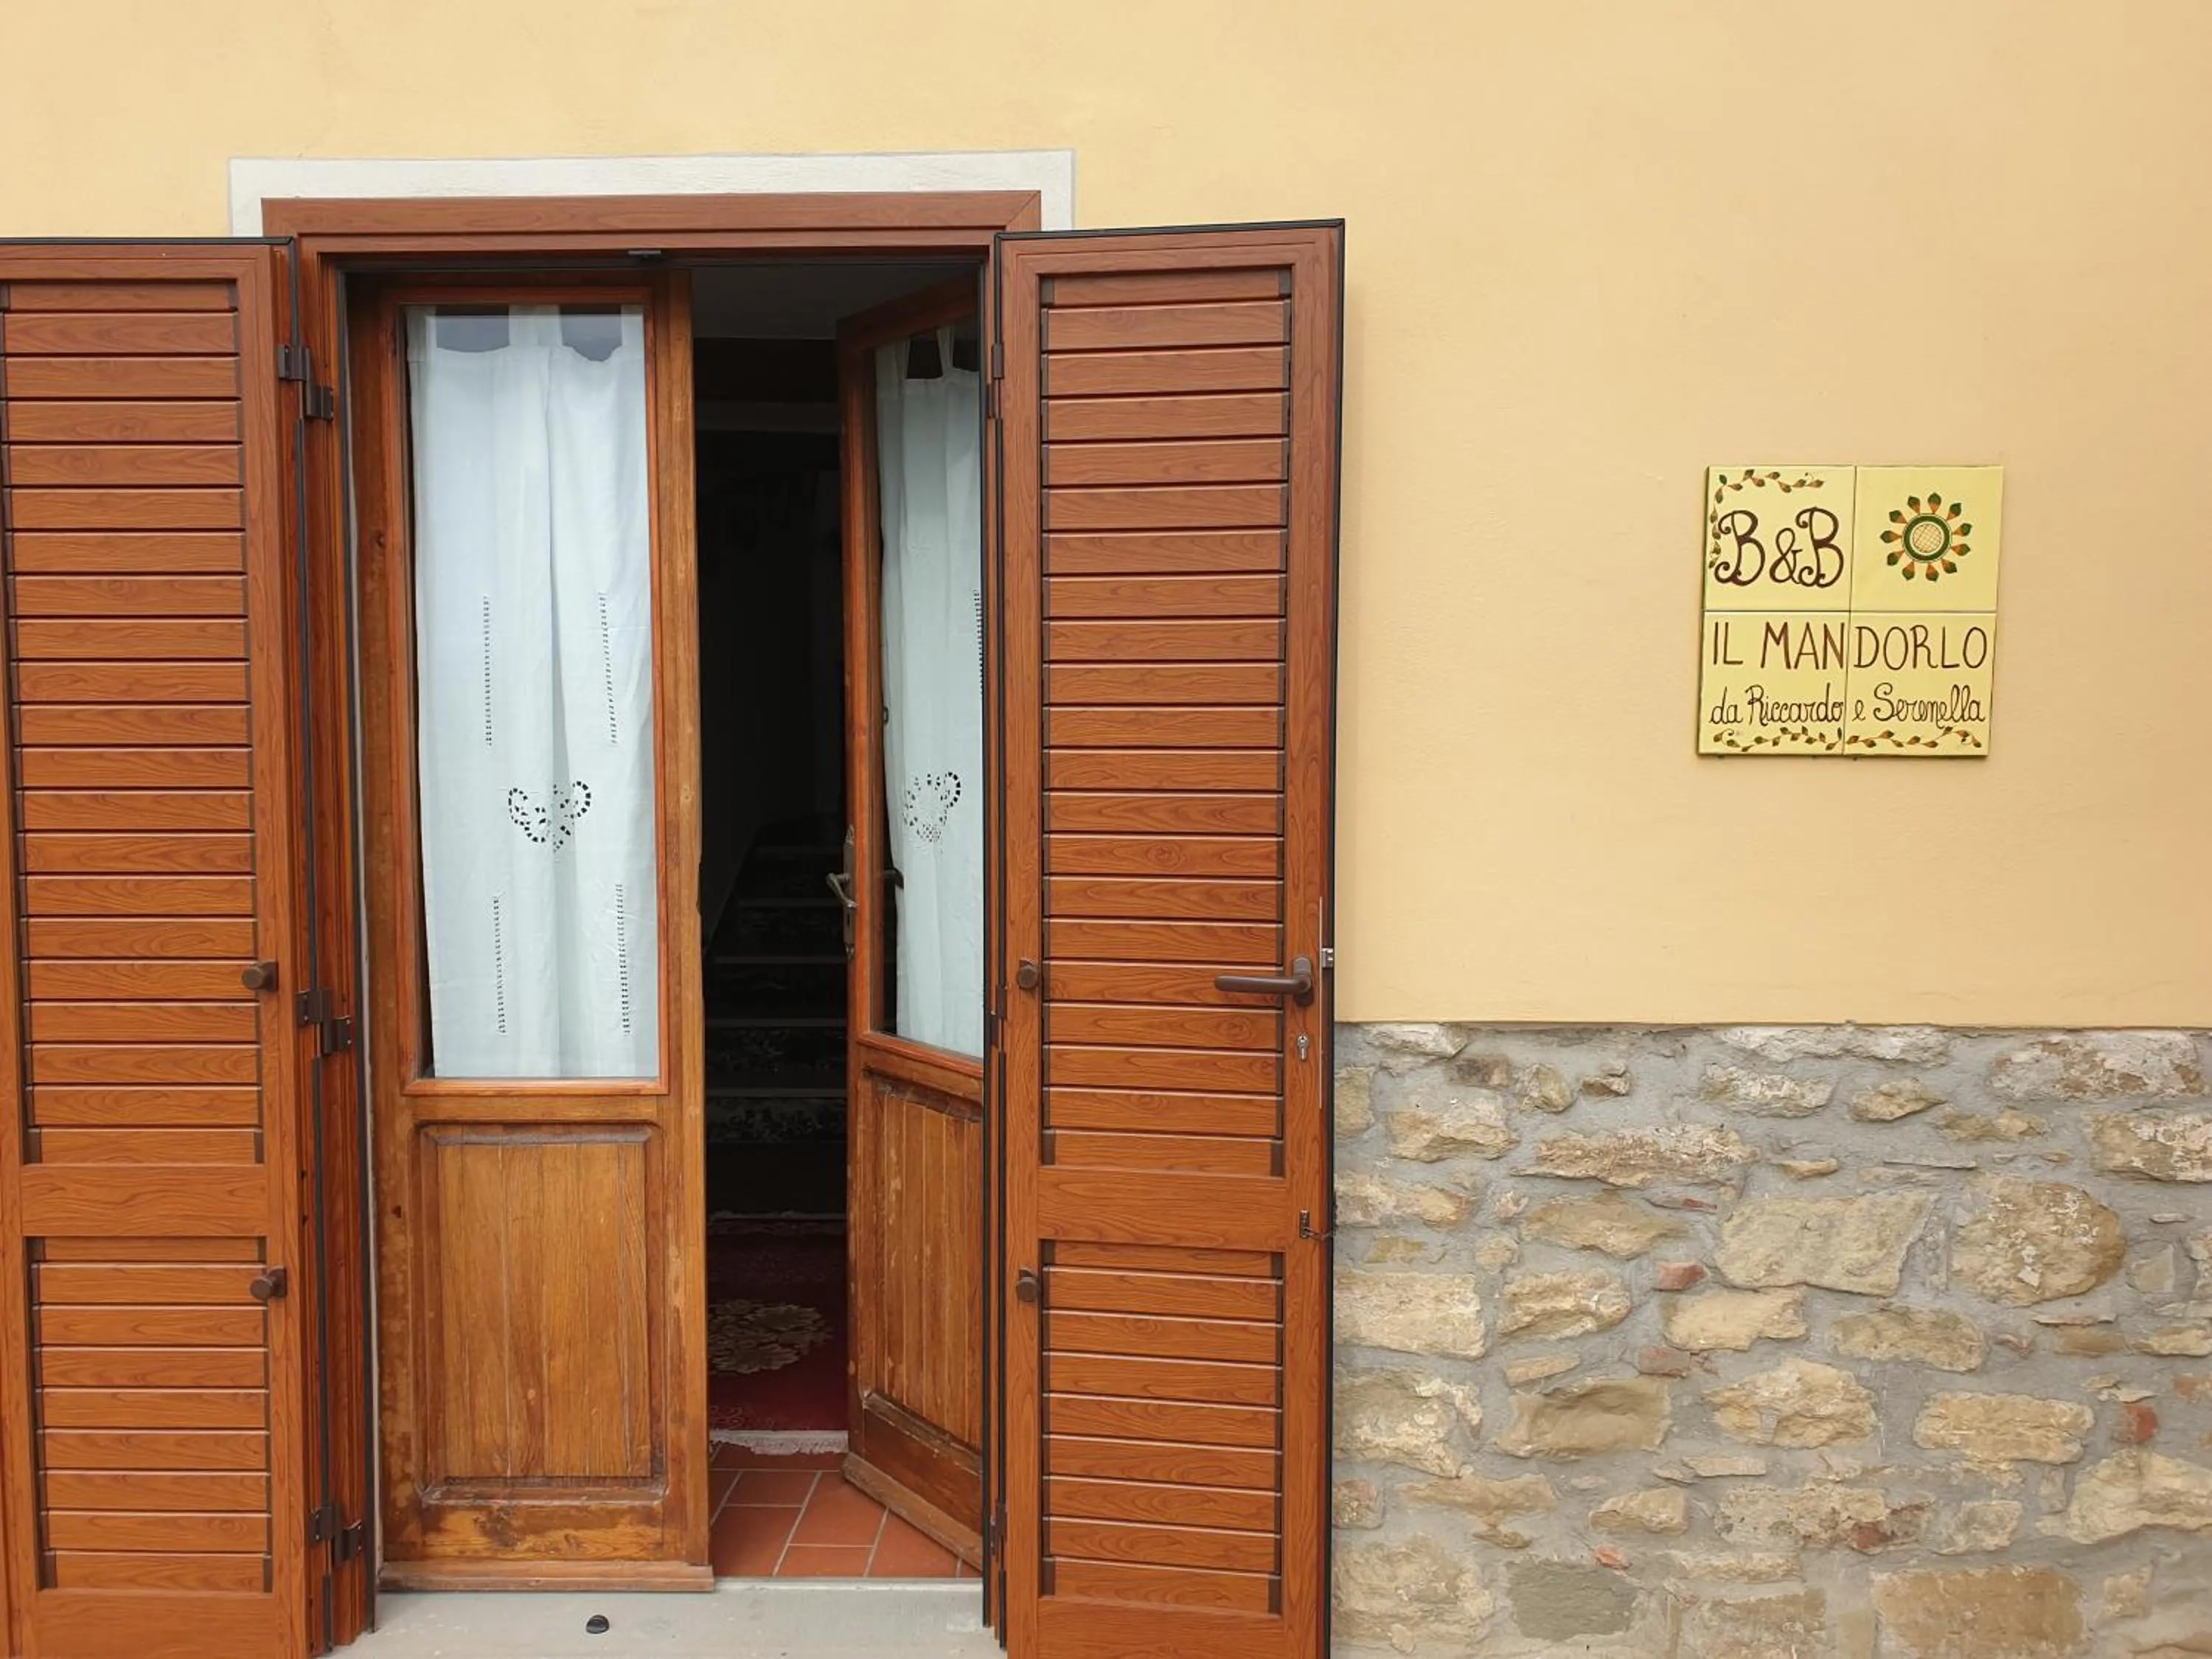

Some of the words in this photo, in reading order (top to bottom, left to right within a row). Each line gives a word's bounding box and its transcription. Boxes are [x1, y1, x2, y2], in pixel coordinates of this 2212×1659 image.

[1714, 507, 1844, 588] B&B
[1713, 622, 1743, 665] IL
[1761, 622, 1987, 670] MANDORLO
[1709, 686, 1743, 725] da
[1745, 682, 1844, 726] Riccardo
[1851, 699, 1866, 722] e
[1874, 682, 1986, 728] Serenella
